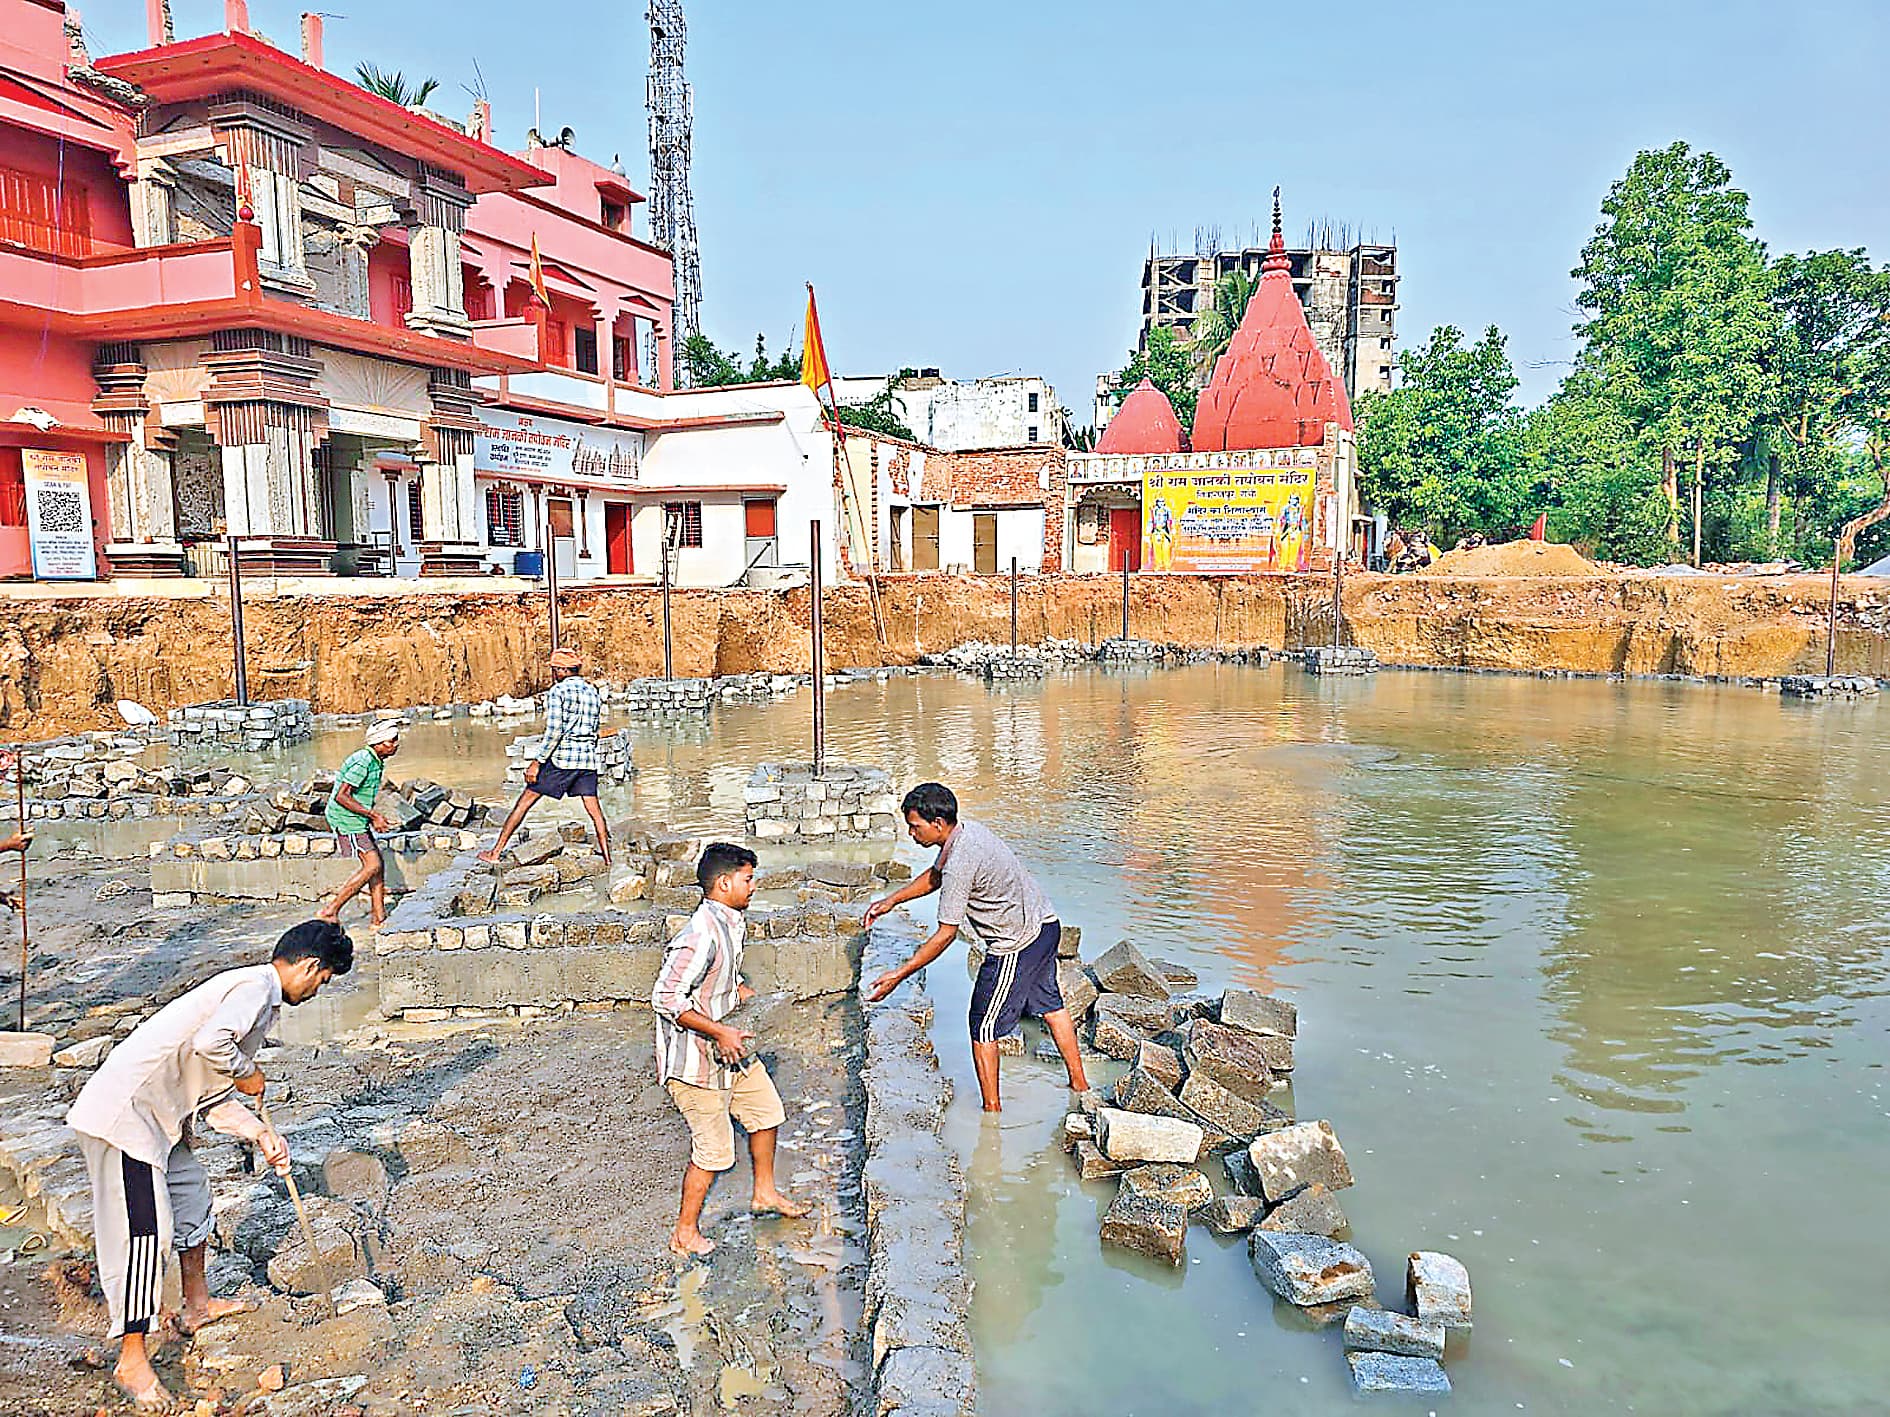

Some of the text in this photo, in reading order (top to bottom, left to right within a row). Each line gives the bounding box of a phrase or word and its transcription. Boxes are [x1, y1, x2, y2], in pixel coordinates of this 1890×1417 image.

[1149, 470, 1309, 488] श्री राम जानकी तपोवन मंदिर
